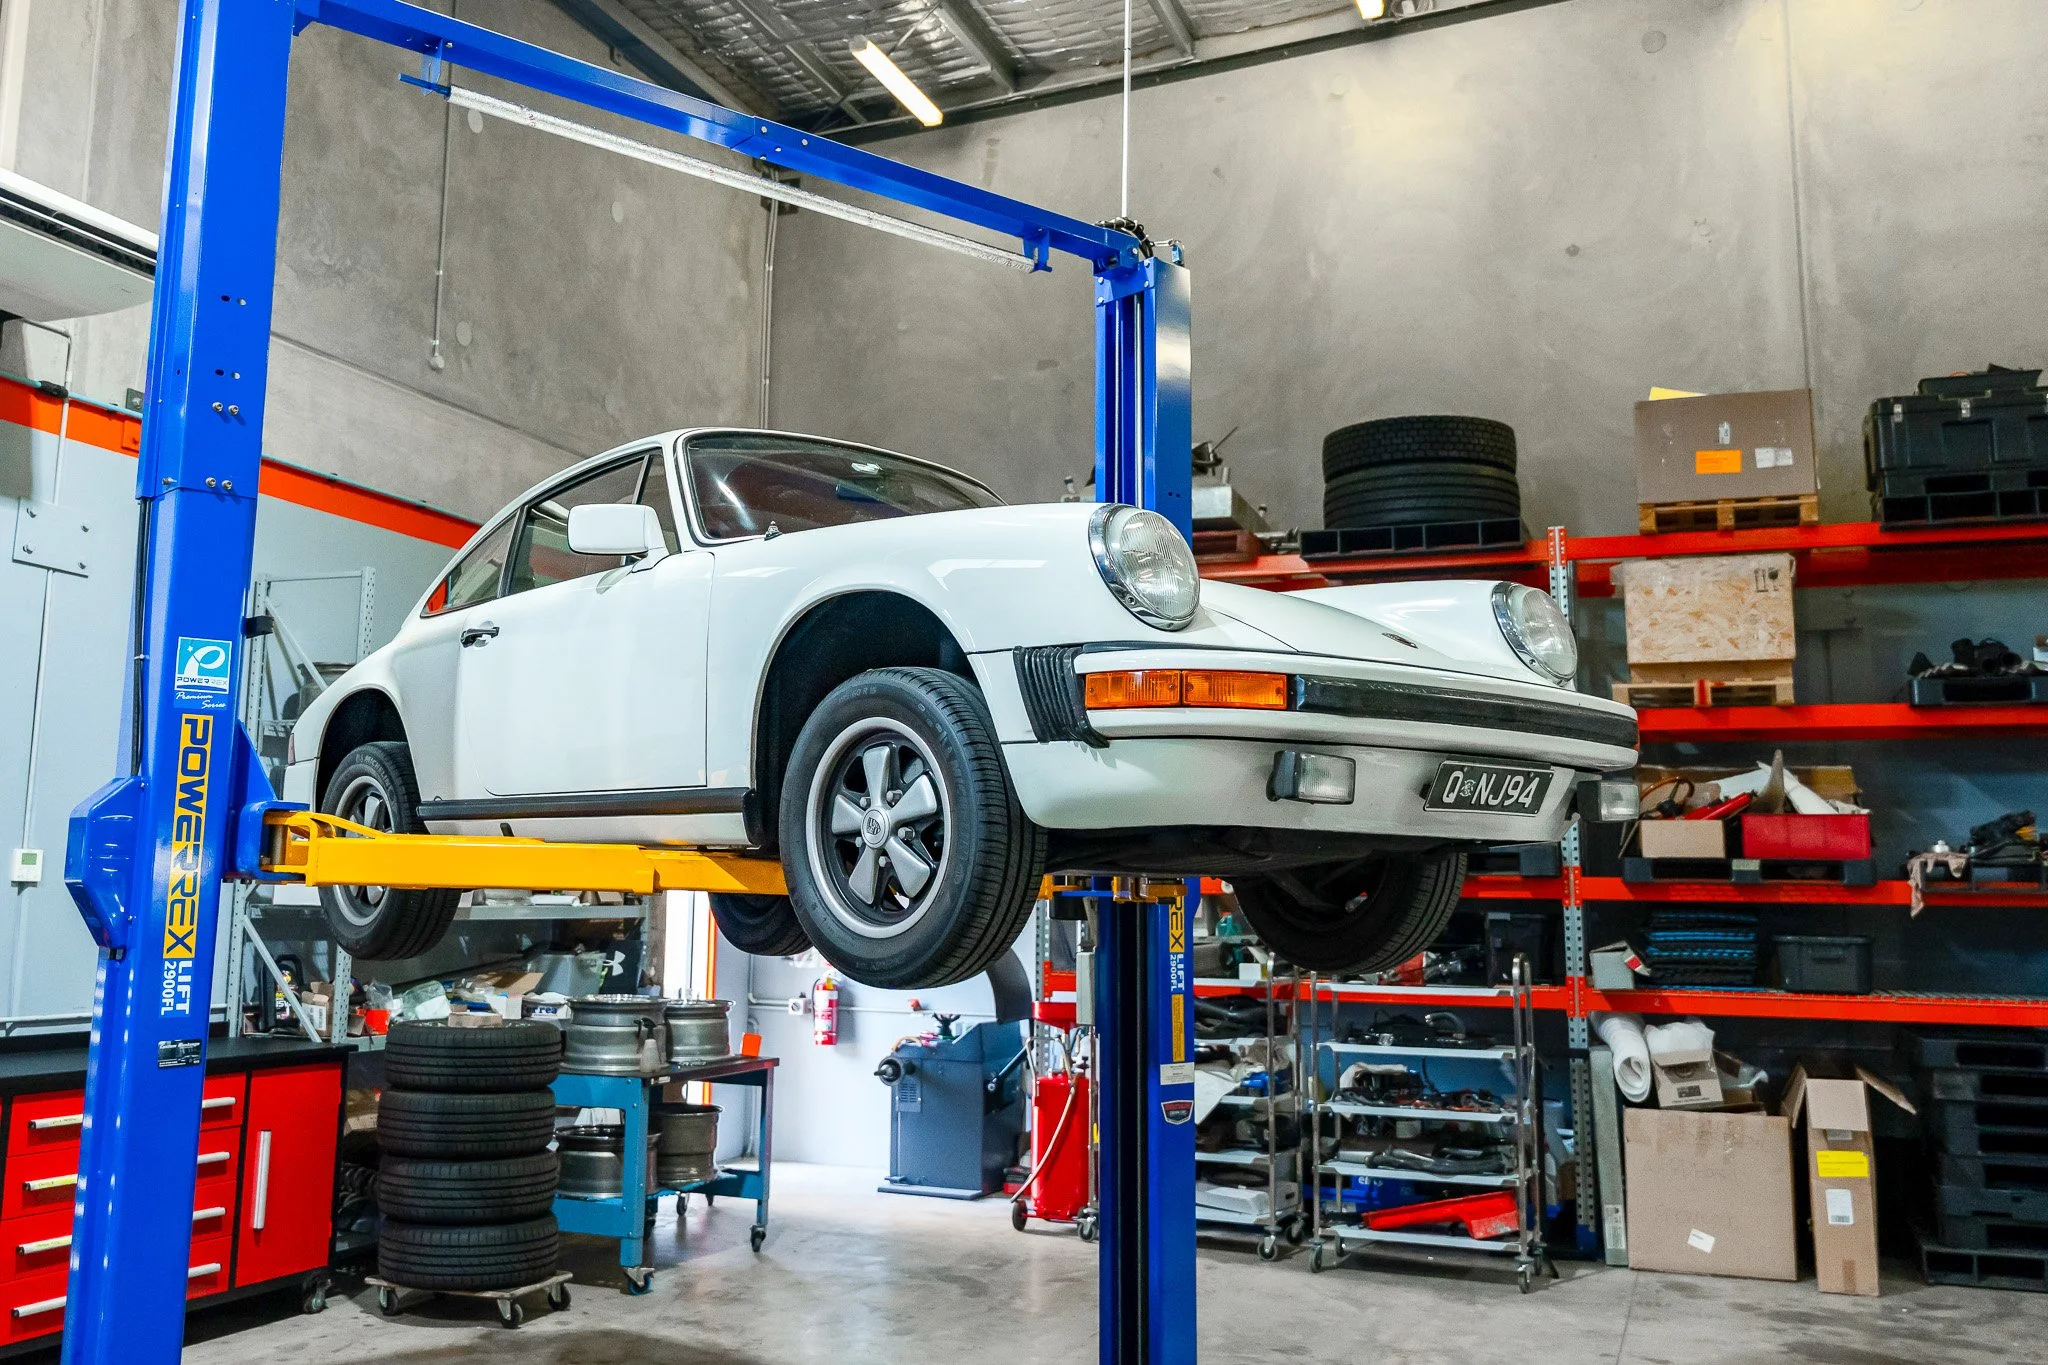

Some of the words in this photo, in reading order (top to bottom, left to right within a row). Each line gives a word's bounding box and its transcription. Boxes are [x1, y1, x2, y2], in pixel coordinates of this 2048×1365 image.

[175, 691, 214, 700] Premium
[201, 699, 227, 709] Series
[1442, 770, 1464, 804] Q
[1470, 772, 1540, 808] NJ94
[166, 717, 210, 955] POWERREX
[160, 960, 177, 1016] 2900FL
[175, 960, 193, 1015] LIFT
[1170, 954, 1178, 992] 2900FL
[1176, 953, 1185, 991] LIFT
